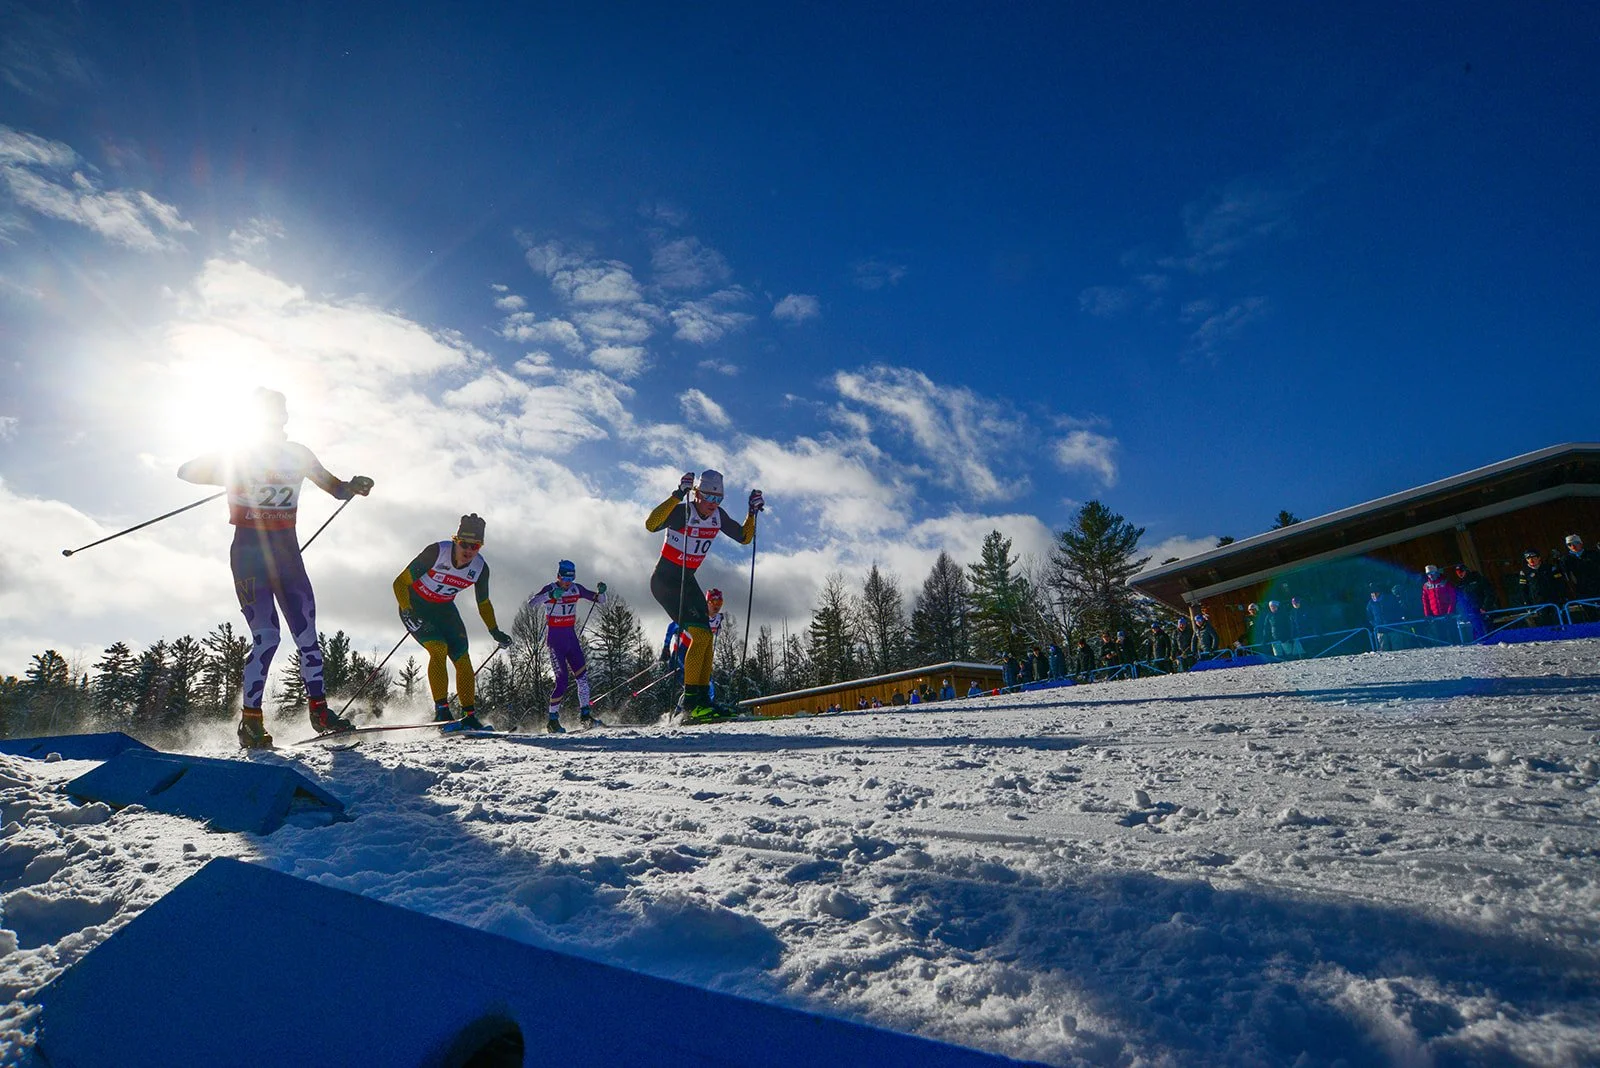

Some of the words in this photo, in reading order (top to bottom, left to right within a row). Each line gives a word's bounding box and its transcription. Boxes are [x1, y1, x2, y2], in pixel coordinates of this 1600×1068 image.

[258, 487, 293, 506] 22
[694, 539, 712, 554] 10
[446, 577, 468, 587] TOYOTA
[561, 603, 575, 615] 17
